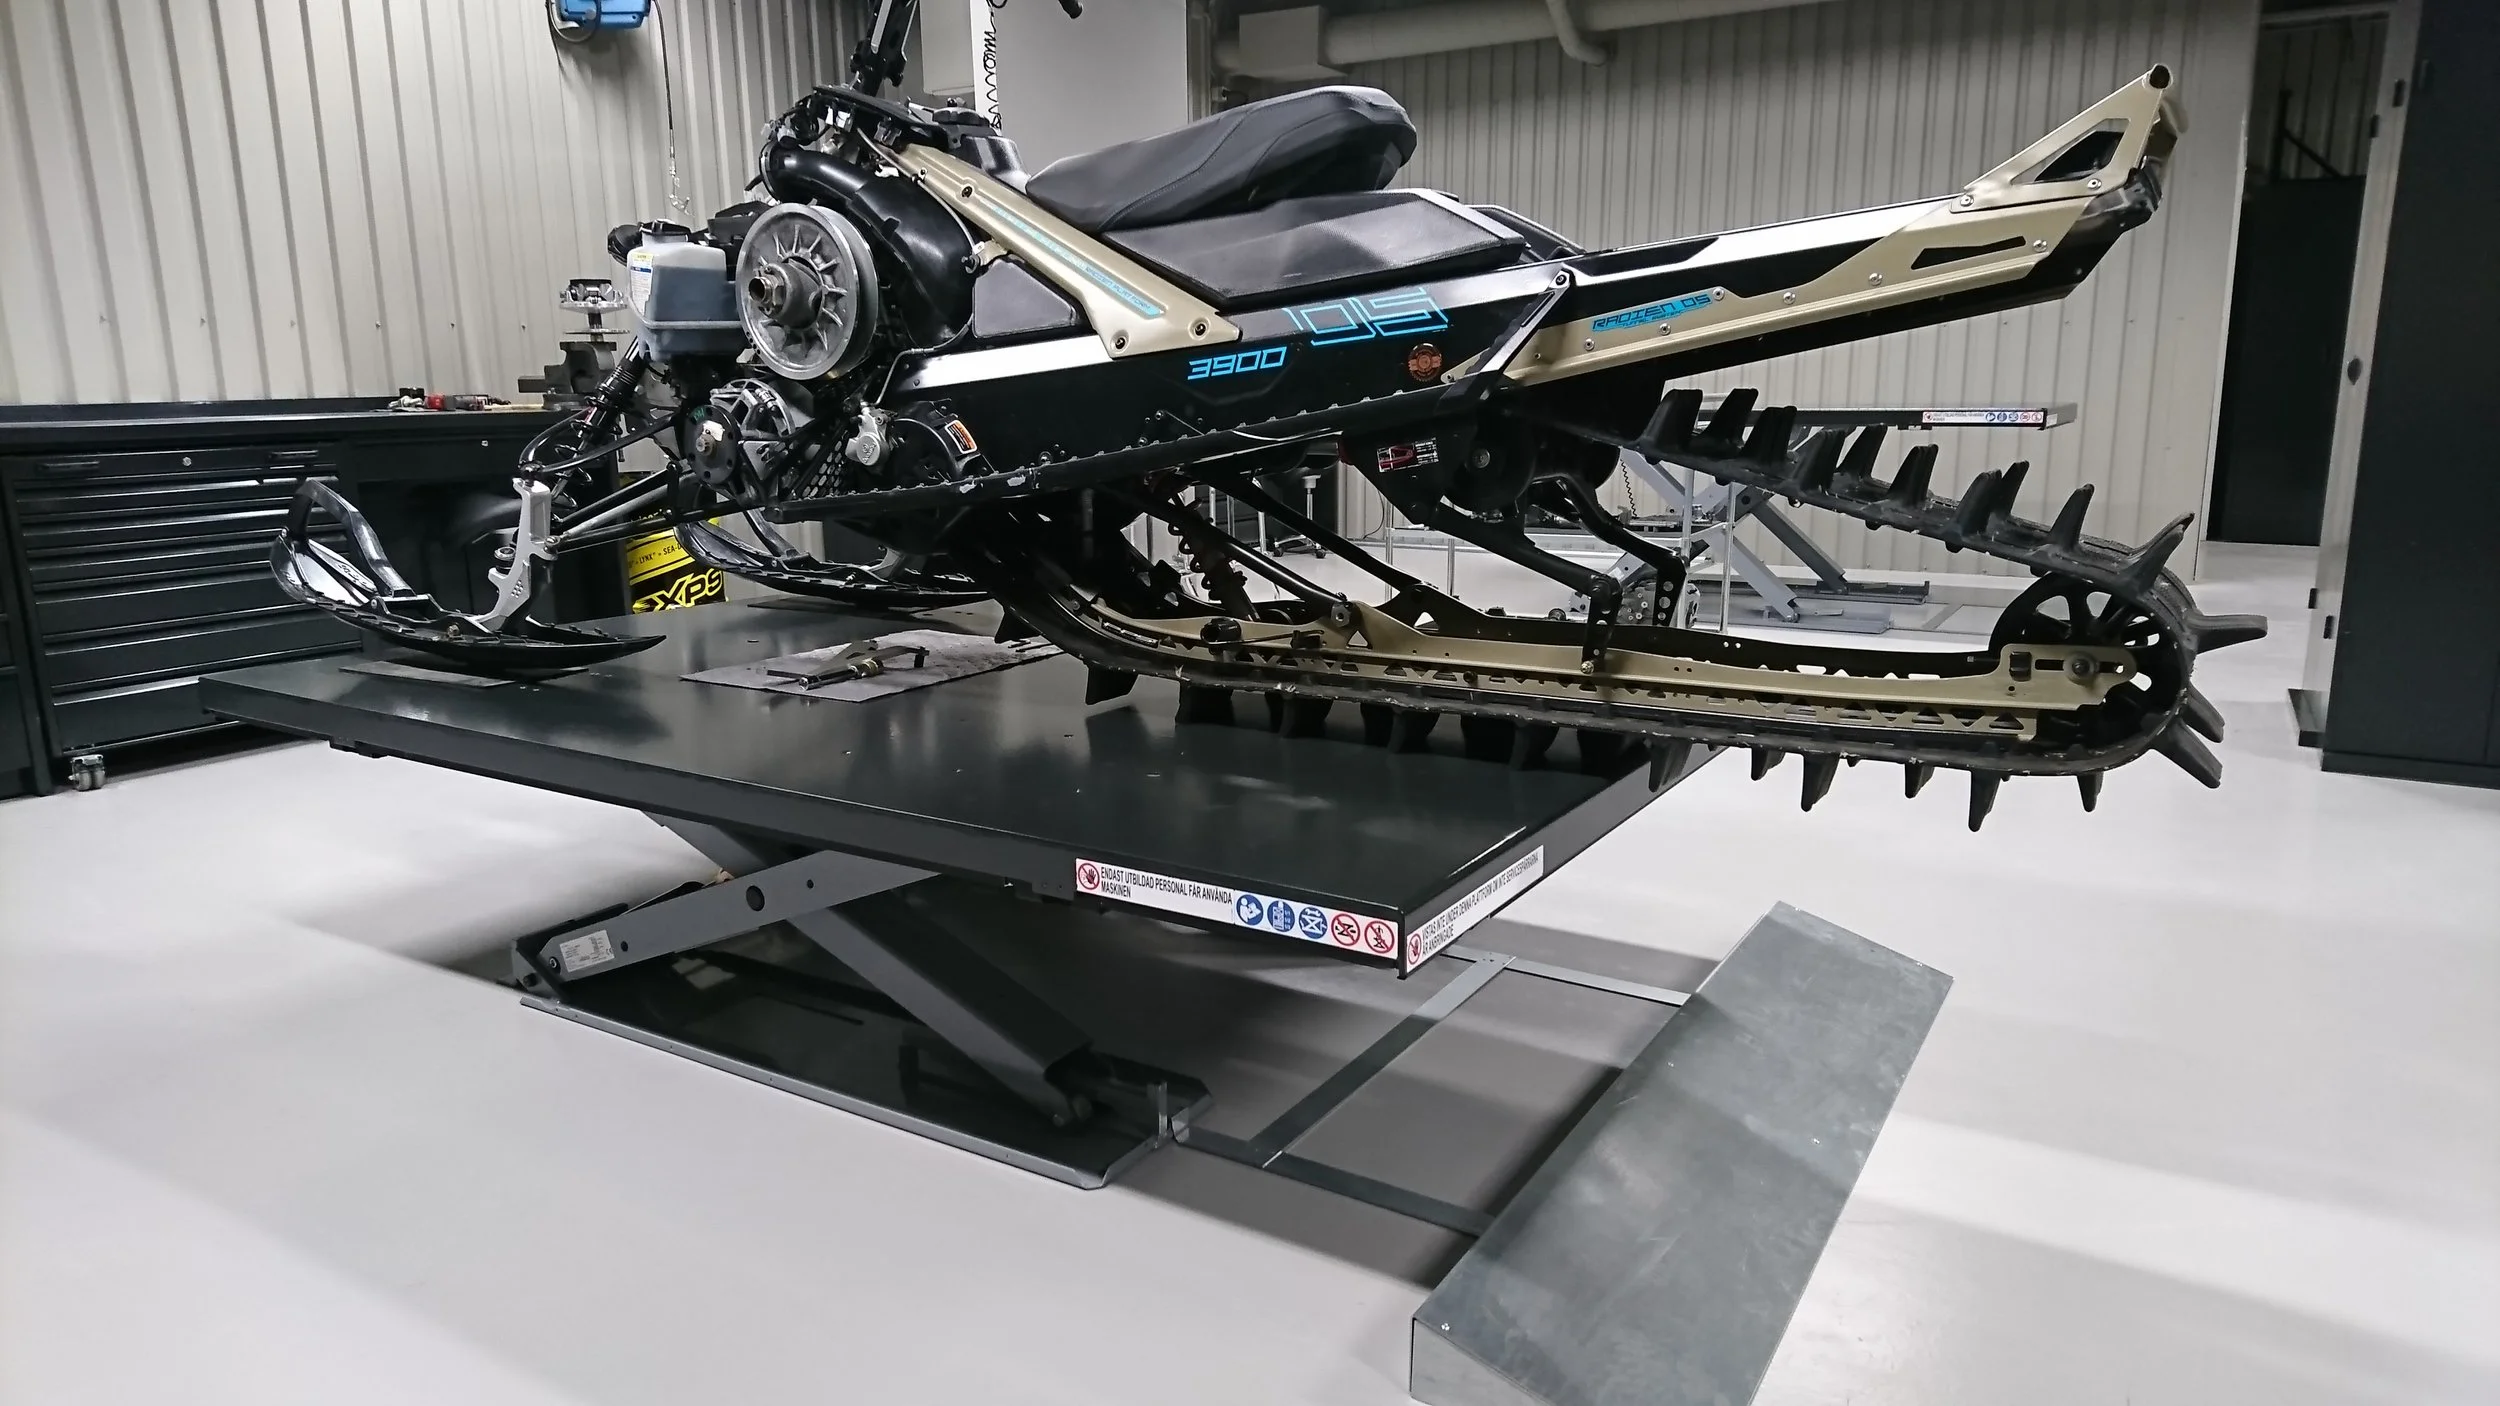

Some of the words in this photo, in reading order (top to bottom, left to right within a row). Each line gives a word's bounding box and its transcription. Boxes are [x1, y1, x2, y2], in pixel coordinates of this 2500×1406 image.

[1592, 303, 1676, 330] RADIEN
[1187, 346, 1287, 380] 3900
[634, 568, 723, 613] XPS
[1100, 866, 1124, 881] ENDAST
[1125, 871, 1154, 889] UTBILDAD
[1155, 878, 1188, 896] PERSONAL
[1101, 880, 1131, 898] MASKINEN
